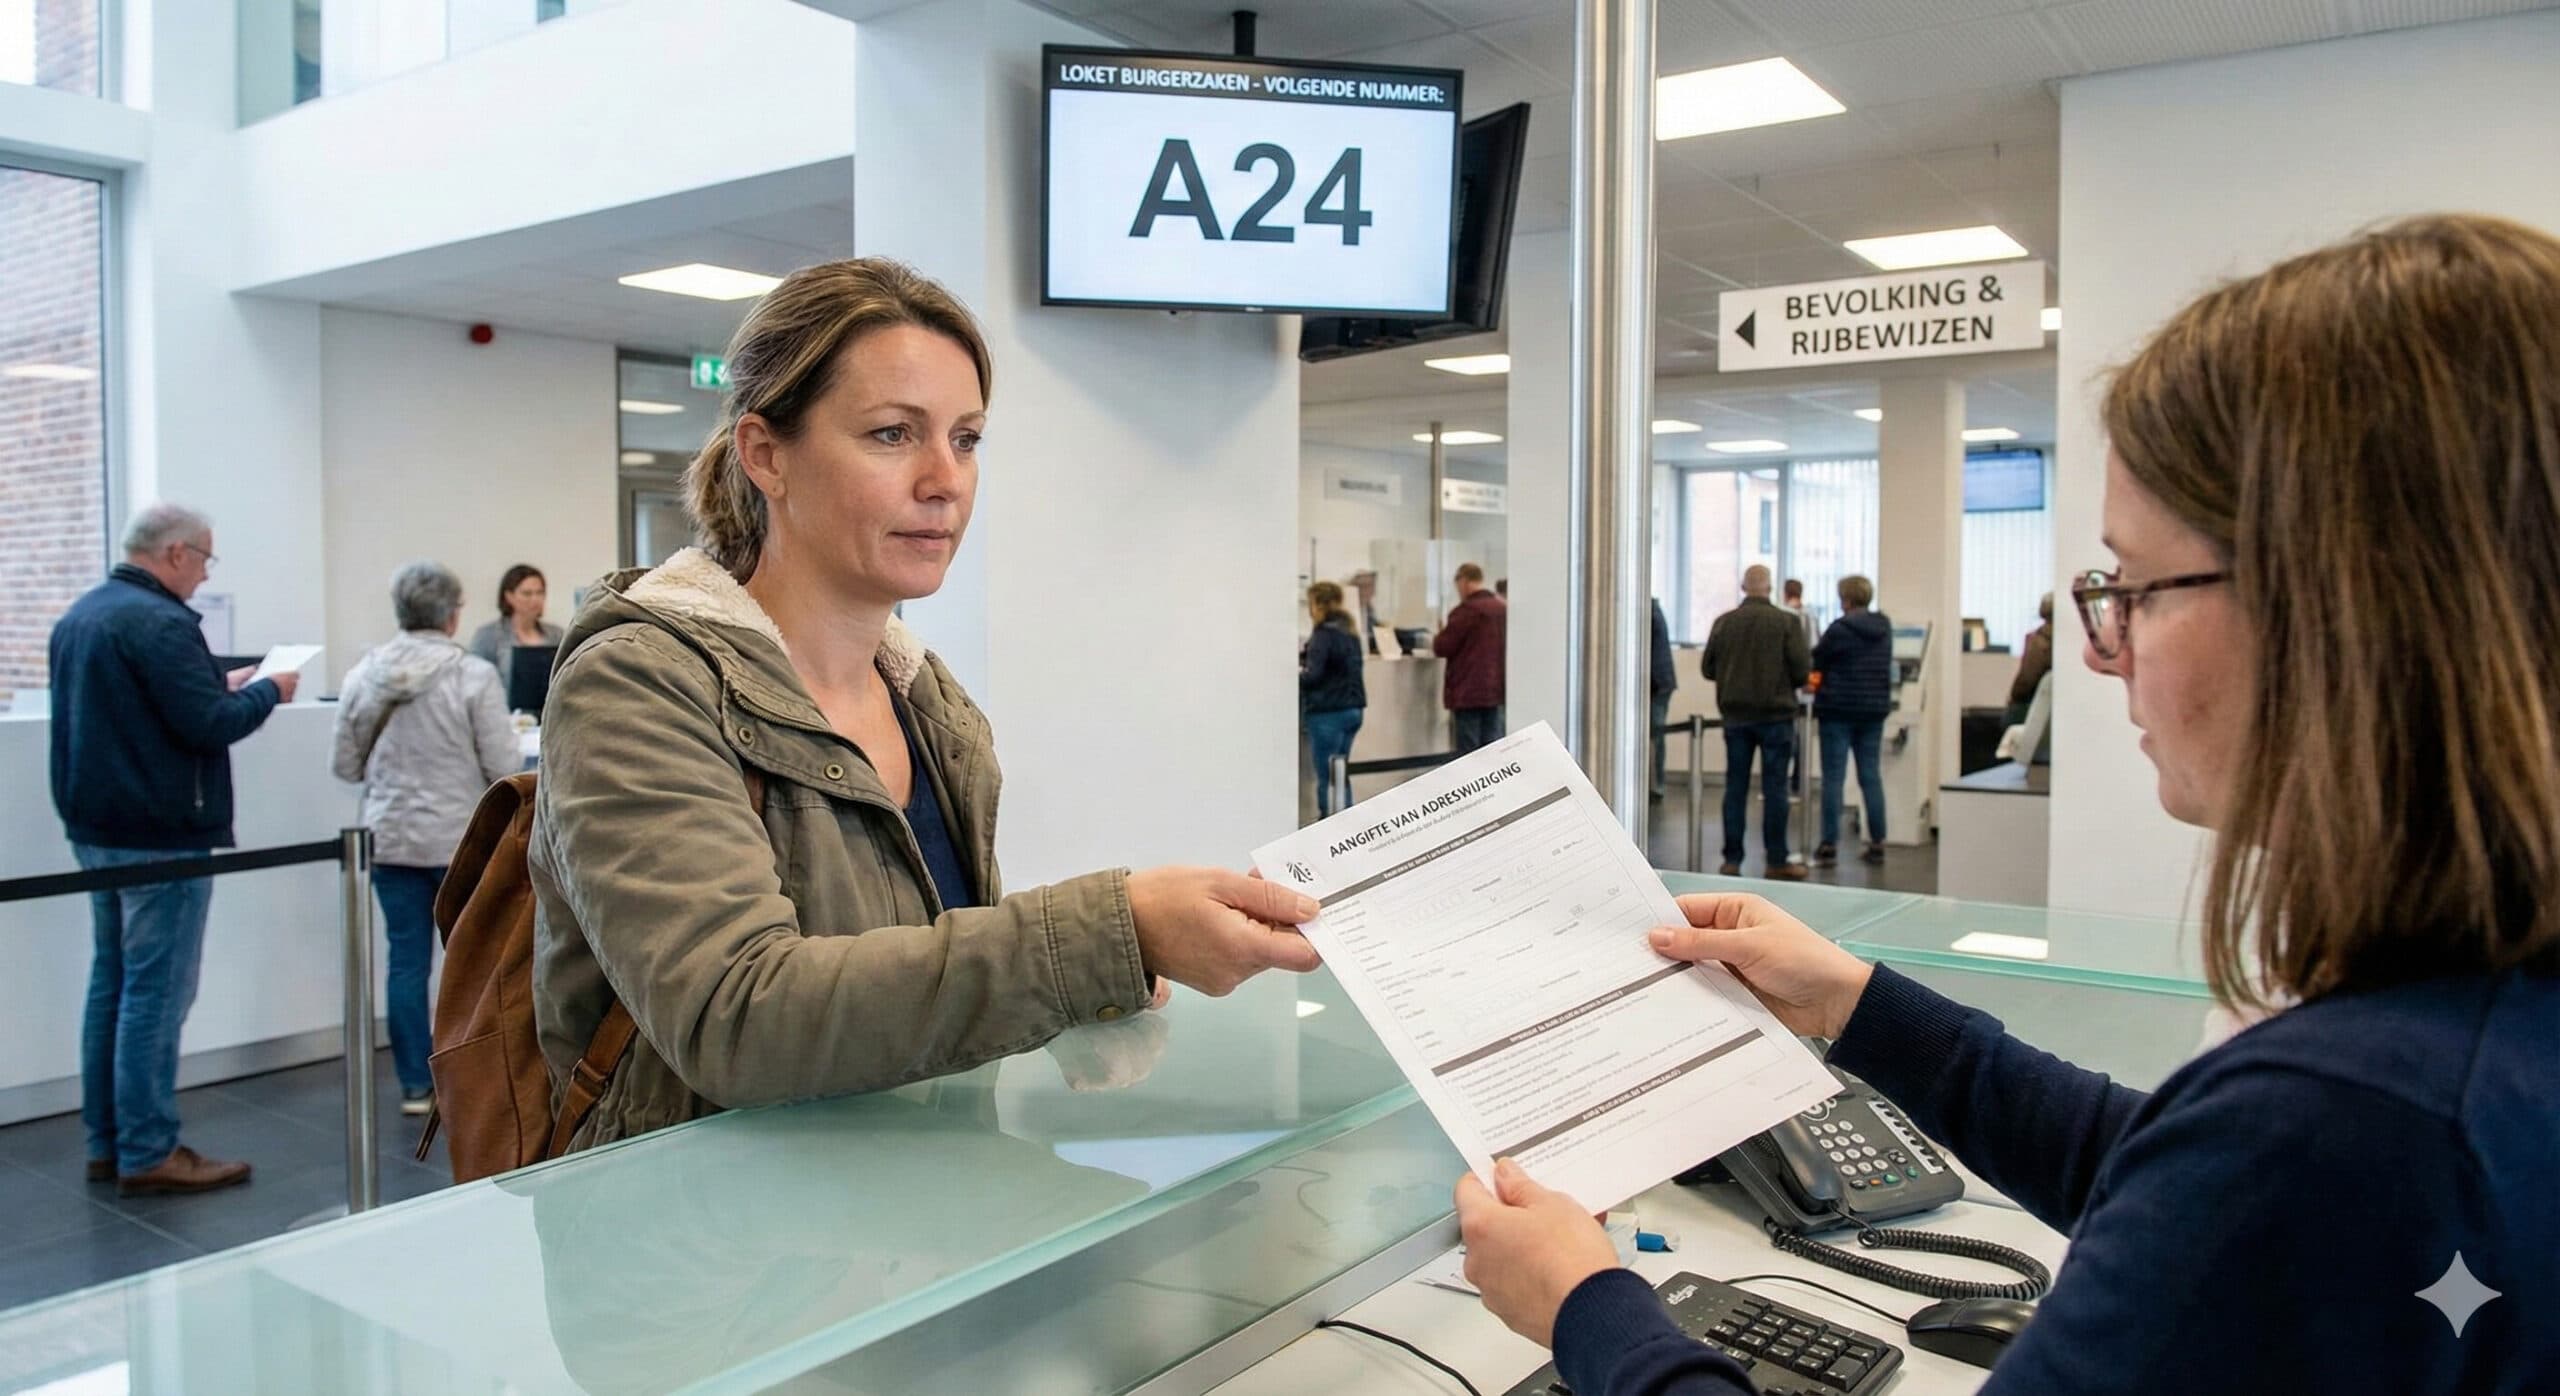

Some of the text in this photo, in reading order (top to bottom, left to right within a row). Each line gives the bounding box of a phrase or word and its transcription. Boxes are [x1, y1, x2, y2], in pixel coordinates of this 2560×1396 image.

[1061, 65, 1117, 85] LOKET
[1121, 68, 1250, 91] BURGERZAKEN
[1265, 76, 1356, 98] VOLGENDE
[1359, 81, 1445, 103] NUMMER:
[1128, 138, 1373, 246] A24
[1785, 275, 2004, 320] BEVOLKING &
[1792, 315, 1993, 355] RIJBEWIJZEN
[1329, 823, 1390, 858] AANGIFTE
[1392, 809, 1420, 829] VAN
[1422, 762, 1522, 816] ADRESWIJZIGING
